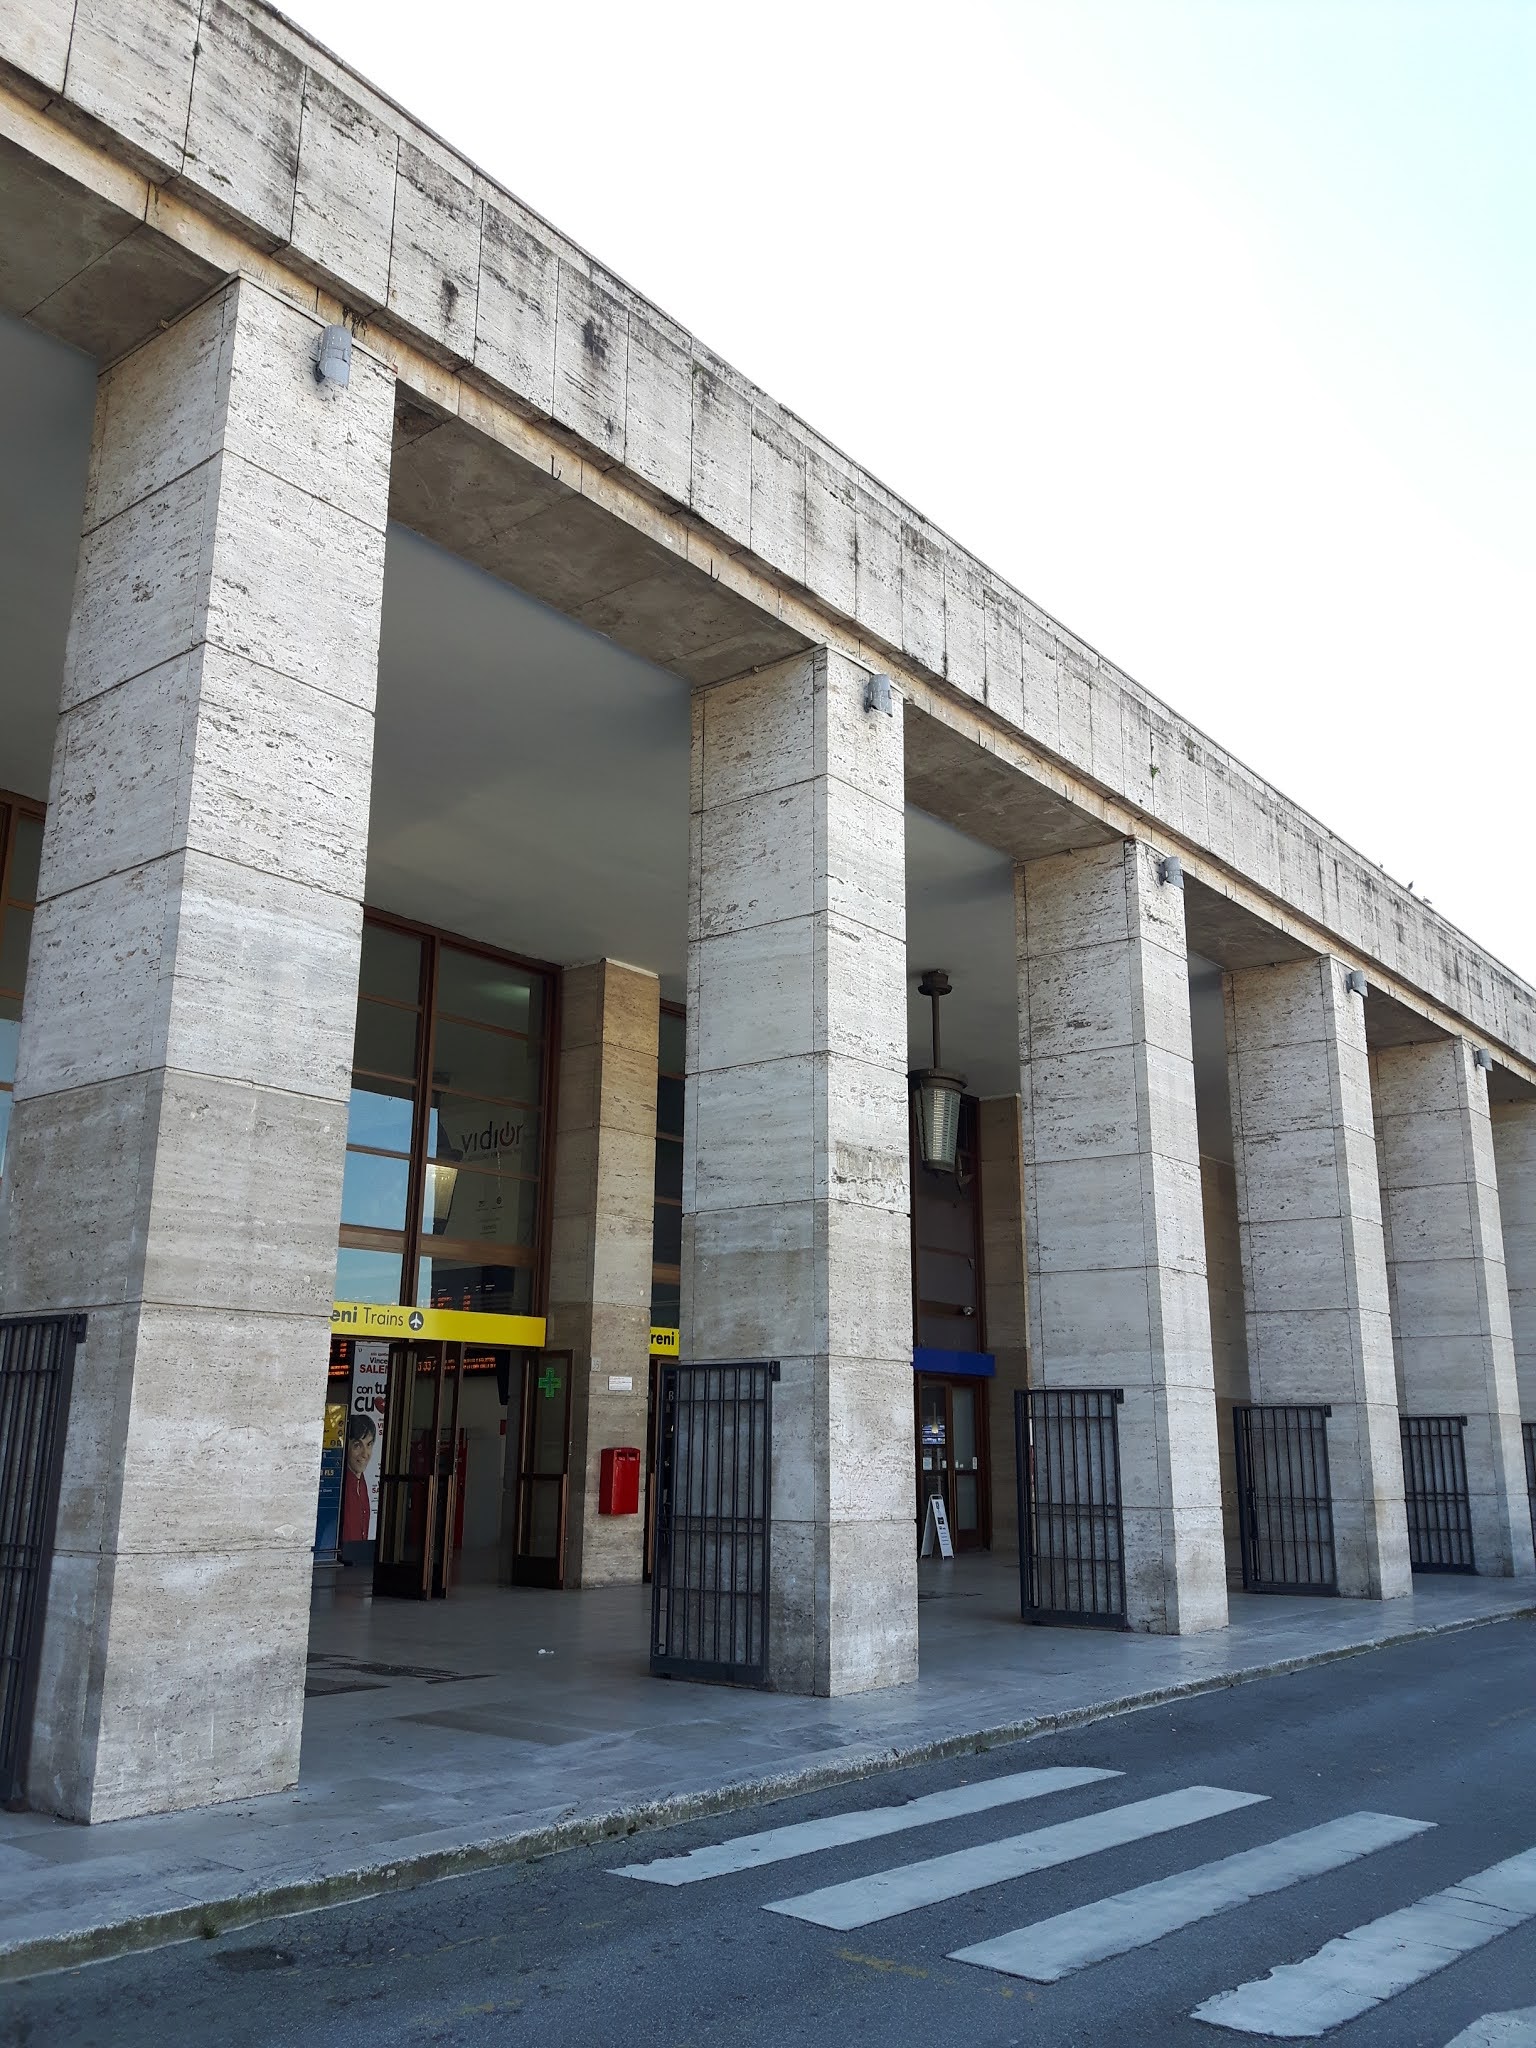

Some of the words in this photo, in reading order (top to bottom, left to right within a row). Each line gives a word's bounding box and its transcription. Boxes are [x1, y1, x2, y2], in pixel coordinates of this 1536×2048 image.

[363, 1307, 404, 1327] Trains
[650, 1330, 675, 1346] reni
[359, 1364, 388, 1374] SALE
[356, 1386, 373, 1395] con
